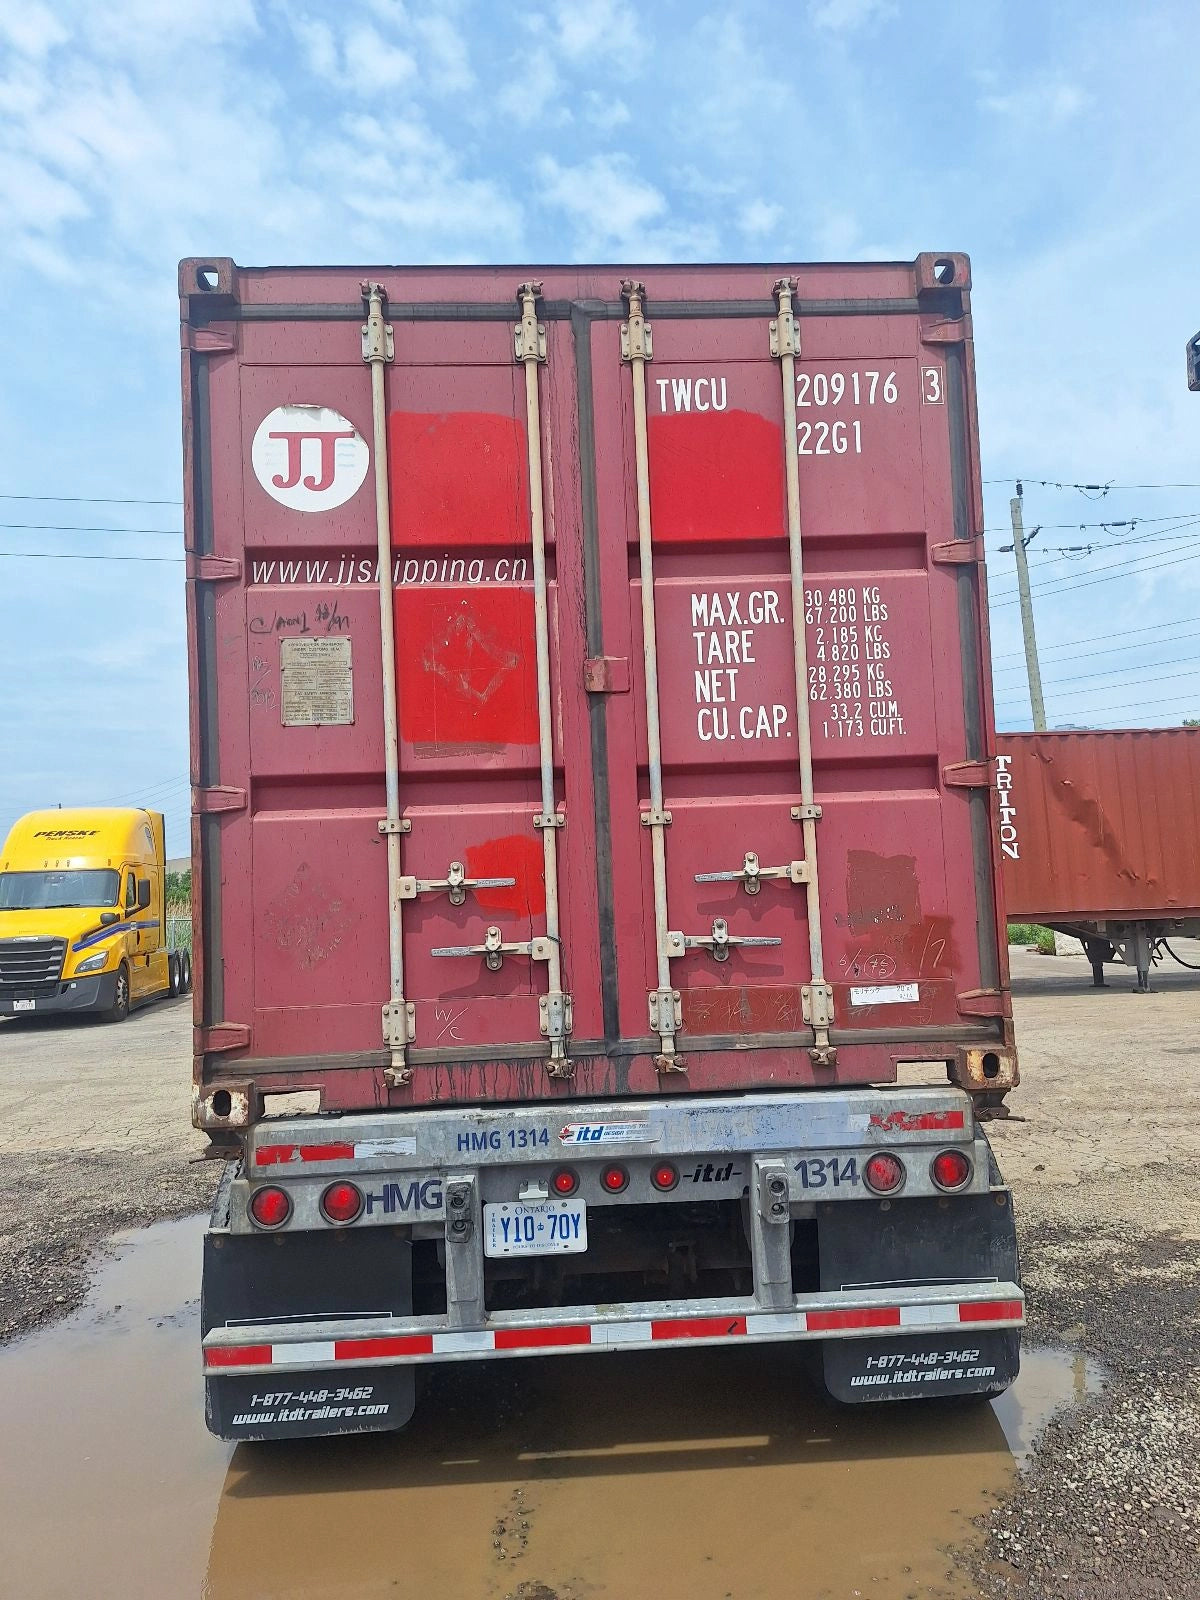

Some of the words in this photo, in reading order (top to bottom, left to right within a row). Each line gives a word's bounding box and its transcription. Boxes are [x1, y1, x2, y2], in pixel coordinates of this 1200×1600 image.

[656, 378, 728, 412] TWCU
[796, 371, 899, 408] 209176
[925, 369, 941, 402] 3
[797, 421, 862, 455] 22G1
[268, 431, 356, 492] JJ
[863, 586, 881, 605] KG
[691, 590, 786, 627] MAX.GR.
[863, 603, 889, 622] LBS
[864, 625, 883, 643] KG
[692, 629, 756, 665] TARE
[865, 641, 891, 660] LBS
[867, 663, 885, 681] KG
[694, 668, 739, 703] NET
[867, 680, 893, 698] LBS
[830, 702, 863, 721] 33.2
[869, 700, 901, 718] CU.M.
[697, 704, 792, 741] CU.CAP.
[995, 755, 1020, 860] TRITON
[457, 1131, 501, 1152] HMG
[507, 1127, 550, 1149] 1314
[576, 1125, 605, 1141] itd
[793, 1157, 862, 1189] 1314
[366, 1179, 443, 1215] HMG
[866, 1349, 980, 1369] 1-877-448-3462
[850, 1366, 996, 1387] www.itdtrailers.com
[250, 1386, 374, 1407] 1-877-448-3462
[231, 1403, 390, 1426] www.itdtrailers.com
